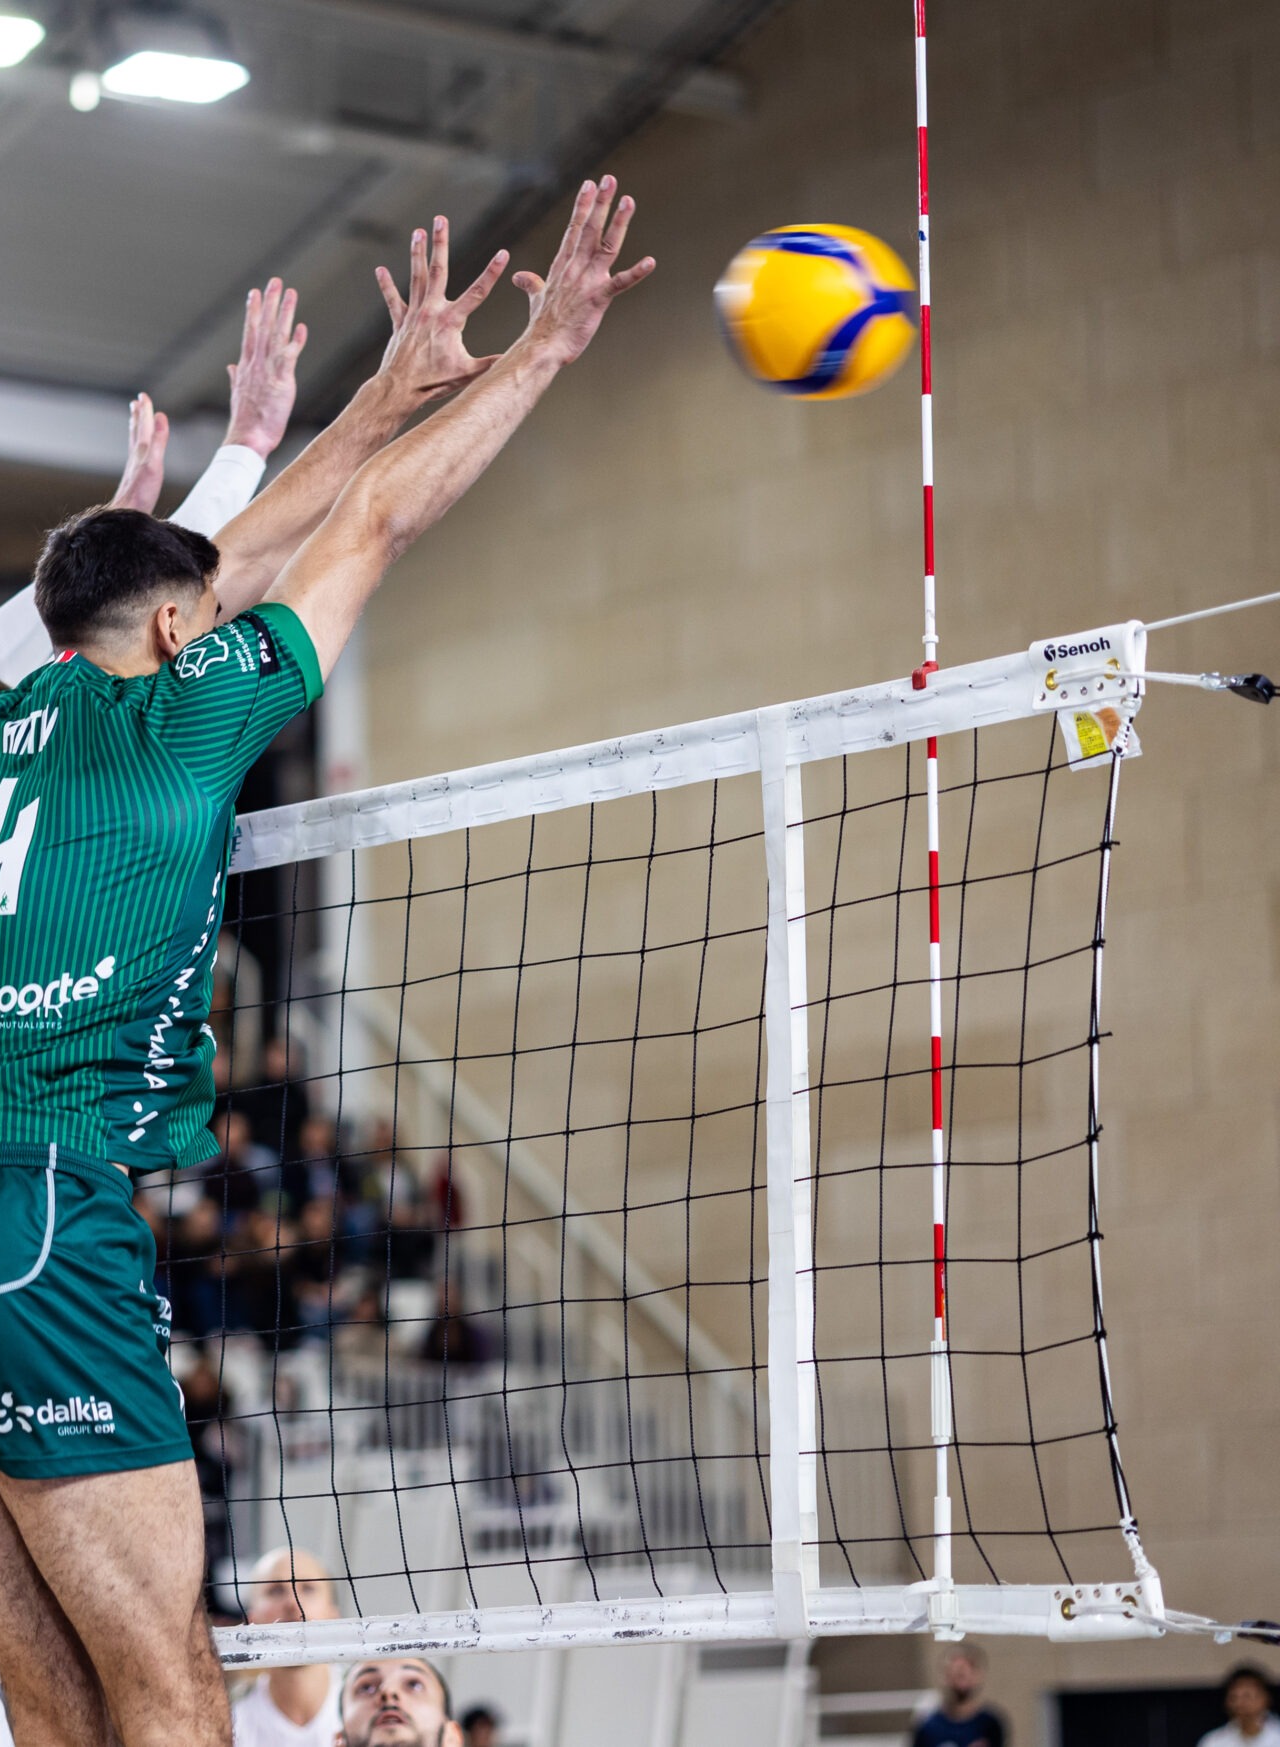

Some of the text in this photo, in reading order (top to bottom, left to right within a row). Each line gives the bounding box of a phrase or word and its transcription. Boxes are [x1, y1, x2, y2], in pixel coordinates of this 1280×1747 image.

[1057, 636, 1111, 660] Senoh
[0, 1019, 63, 1030] MUTUALISTES
[36, 1395, 114, 1425] dalkia
